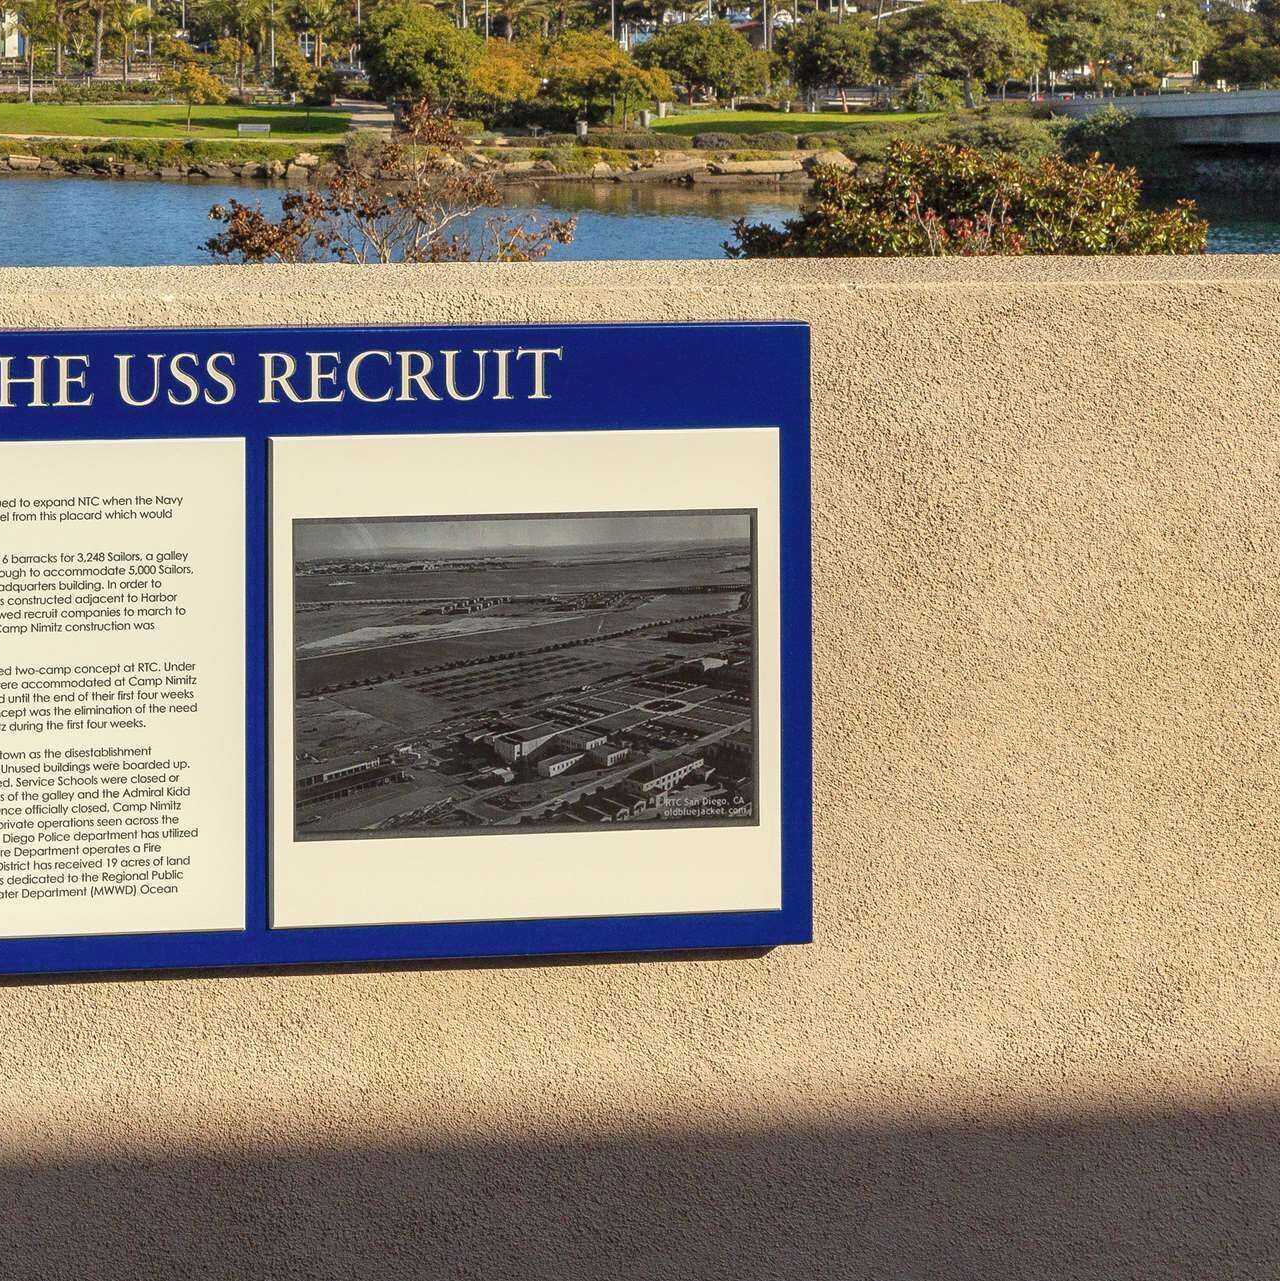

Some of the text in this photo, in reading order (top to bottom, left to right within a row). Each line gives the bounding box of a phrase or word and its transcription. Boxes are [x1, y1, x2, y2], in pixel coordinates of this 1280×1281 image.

[113, 353, 236, 406] USS
[258, 346, 563, 403] RECRUIT
[19, 498, 30, 508] to
[33, 497, 75, 510] expand
[78, 497, 99, 507] NTC
[102, 496, 132, 506] when
[135, 496, 152, 506] the
[155, 495, 183, 507] Navy
[12, 512, 36, 522] from
[39, 511, 56, 521] this
[59, 510, 102, 523] placard
[104, 510, 137, 520] which
[139, 509, 172, 519] would
[11, 553, 57, 564] barracks
[60, 553, 75, 563] for
[76, 552, 105, 565] 3,248
[107, 552, 142, 564] Sailors,
[155, 551, 188, 563] galley
[29, 567, 40, 577] to
[42, 566, 126, 577] accommodate
[128, 565, 156, 577] 5,000
[158, 564, 193, 577] Sailors,
[30, 622, 62, 633] Nimitz
[64, 621, 130, 632] construction
[133, 622, 154, 630] was
[15, 665, 71, 678] two-camp
[73, 663, 120, 676] concept
[123, 663, 135, 673] at
[137, 662, 160, 673] RTC.
[164, 662, 195, 672] Under
[8, 721, 43, 734] during
[46, 720, 63, 730] the
[66, 720, 83, 730] first
[86, 719, 107, 729] four
[109, 718, 146, 729] weeks.
[28, 751, 41, 759] as
[44, 749, 61, 759] the
[64, 746, 151, 758] disestablishment
[0, 763, 40, 774] Unused
[43, 762, 90, 775] buildings
[92, 763, 120, 771] were
[122, 759, 170, 770] boarded
[173, 761, 190, 771] up.
[684, 799, 700, 807] San
[733, 796, 745, 805] CA
[21, 886, 87, 901] Department
[90, 885, 136, 898] (MWWD)
[139, 883, 178, 894] Ocean
